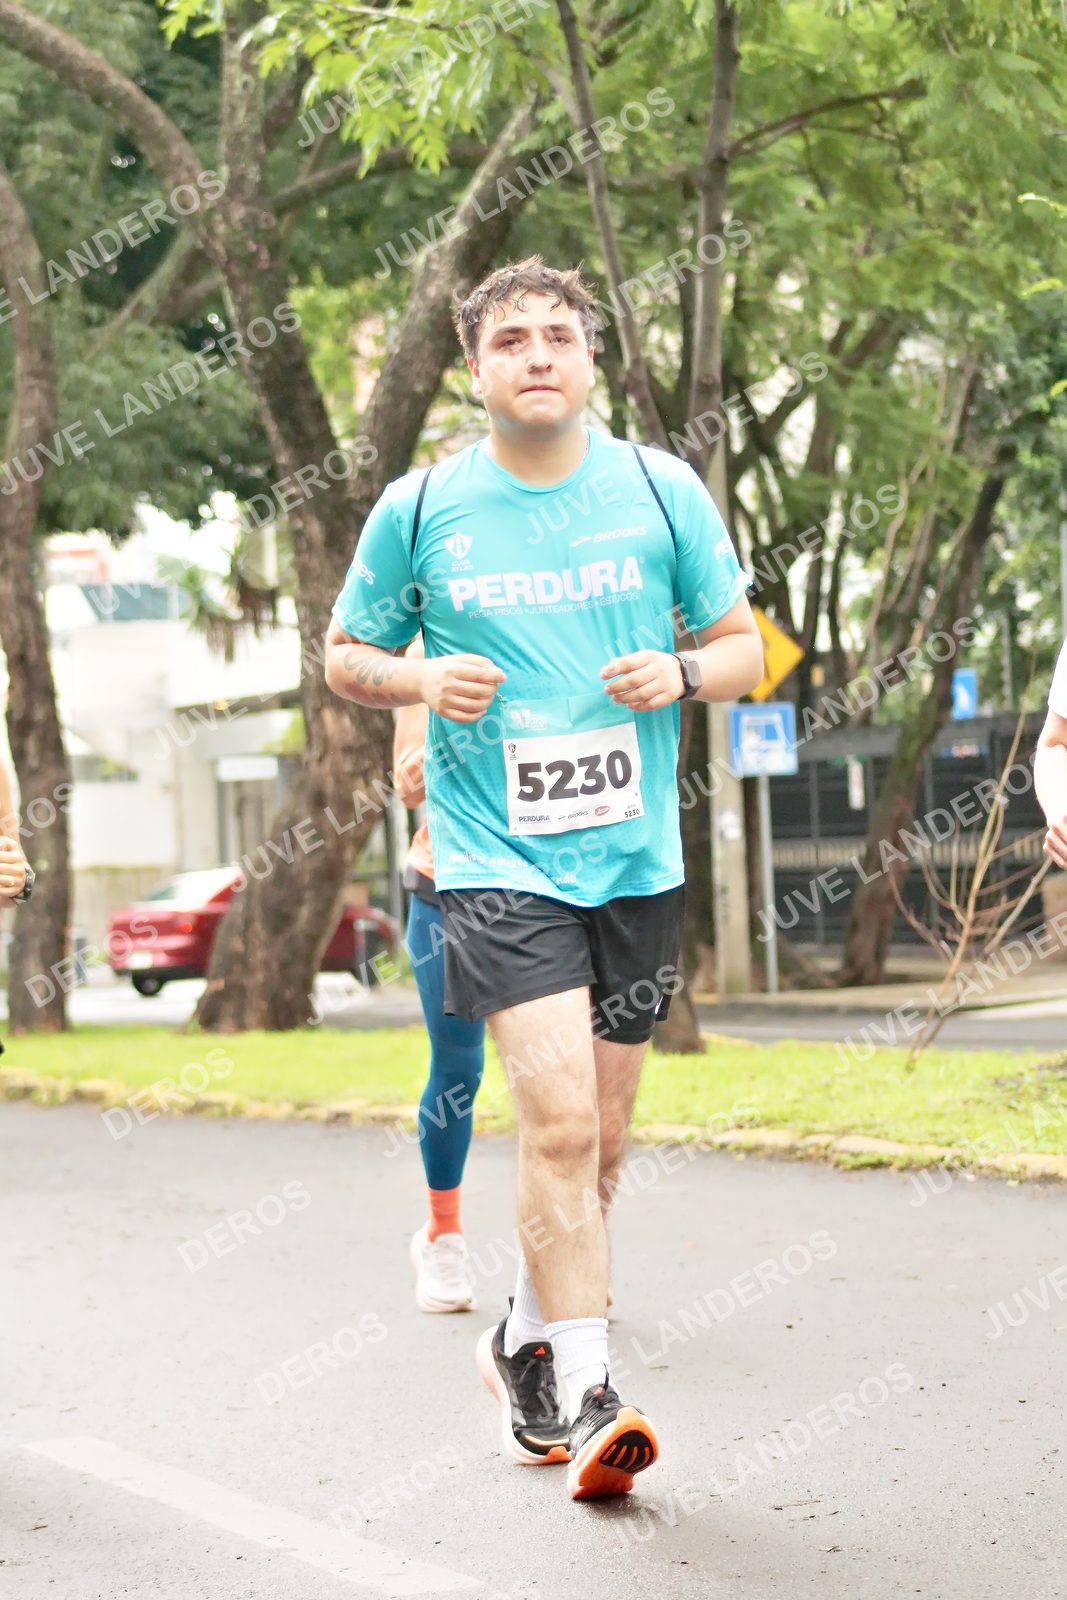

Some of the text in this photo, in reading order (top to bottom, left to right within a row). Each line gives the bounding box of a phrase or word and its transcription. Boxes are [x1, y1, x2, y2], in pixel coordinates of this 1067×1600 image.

[592, 526, 648, 543] BROOKS
[447, 556, 643, 612] PERDURA
[599, 592, 640, 605] ESTUCOS
[517, 749, 632, 802] 5230
[624, 808, 640, 818] 5230
